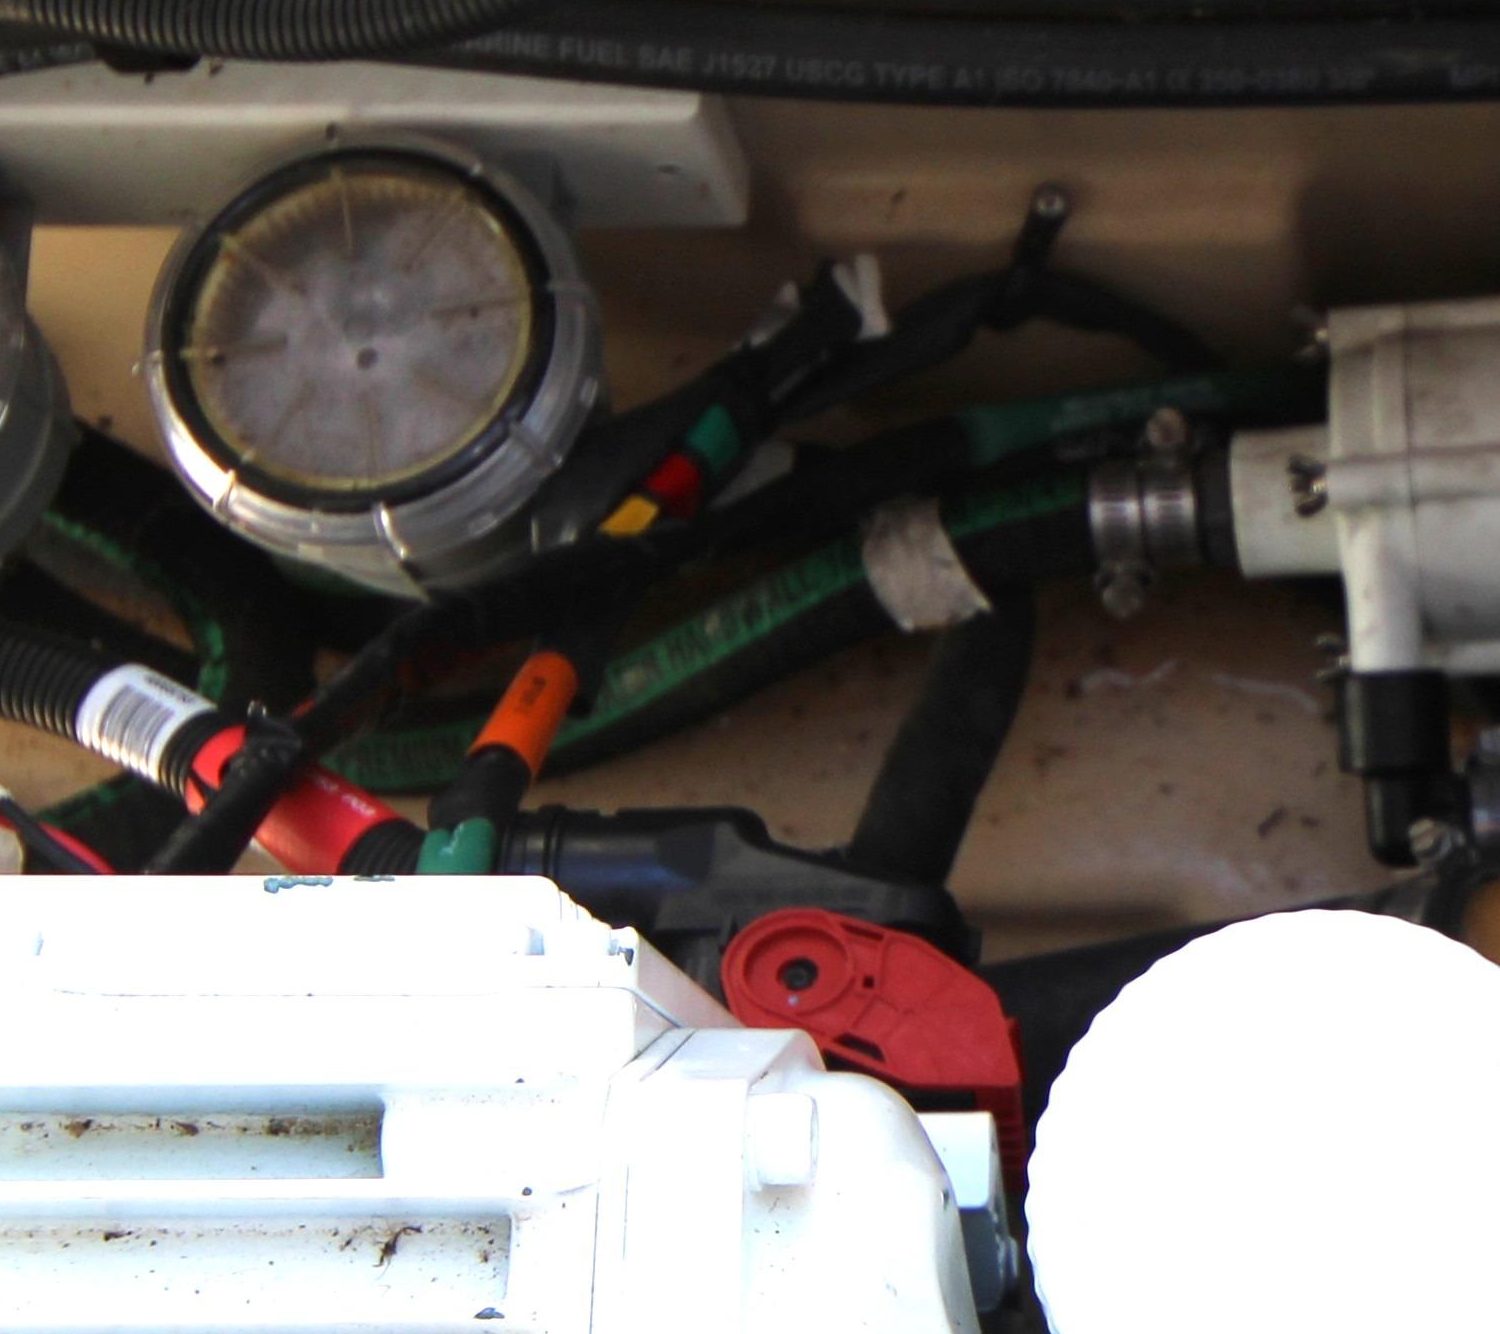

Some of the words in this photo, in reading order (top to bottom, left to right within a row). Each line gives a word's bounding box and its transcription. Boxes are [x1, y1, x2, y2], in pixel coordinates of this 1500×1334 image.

[558, 36, 630, 67] FUEL
[638, 40, 695, 73] SAE
[702, 48, 778, 79] J1527
[786, 58, 867, 87] USCG
[873, 61, 942, 91] TYPE
